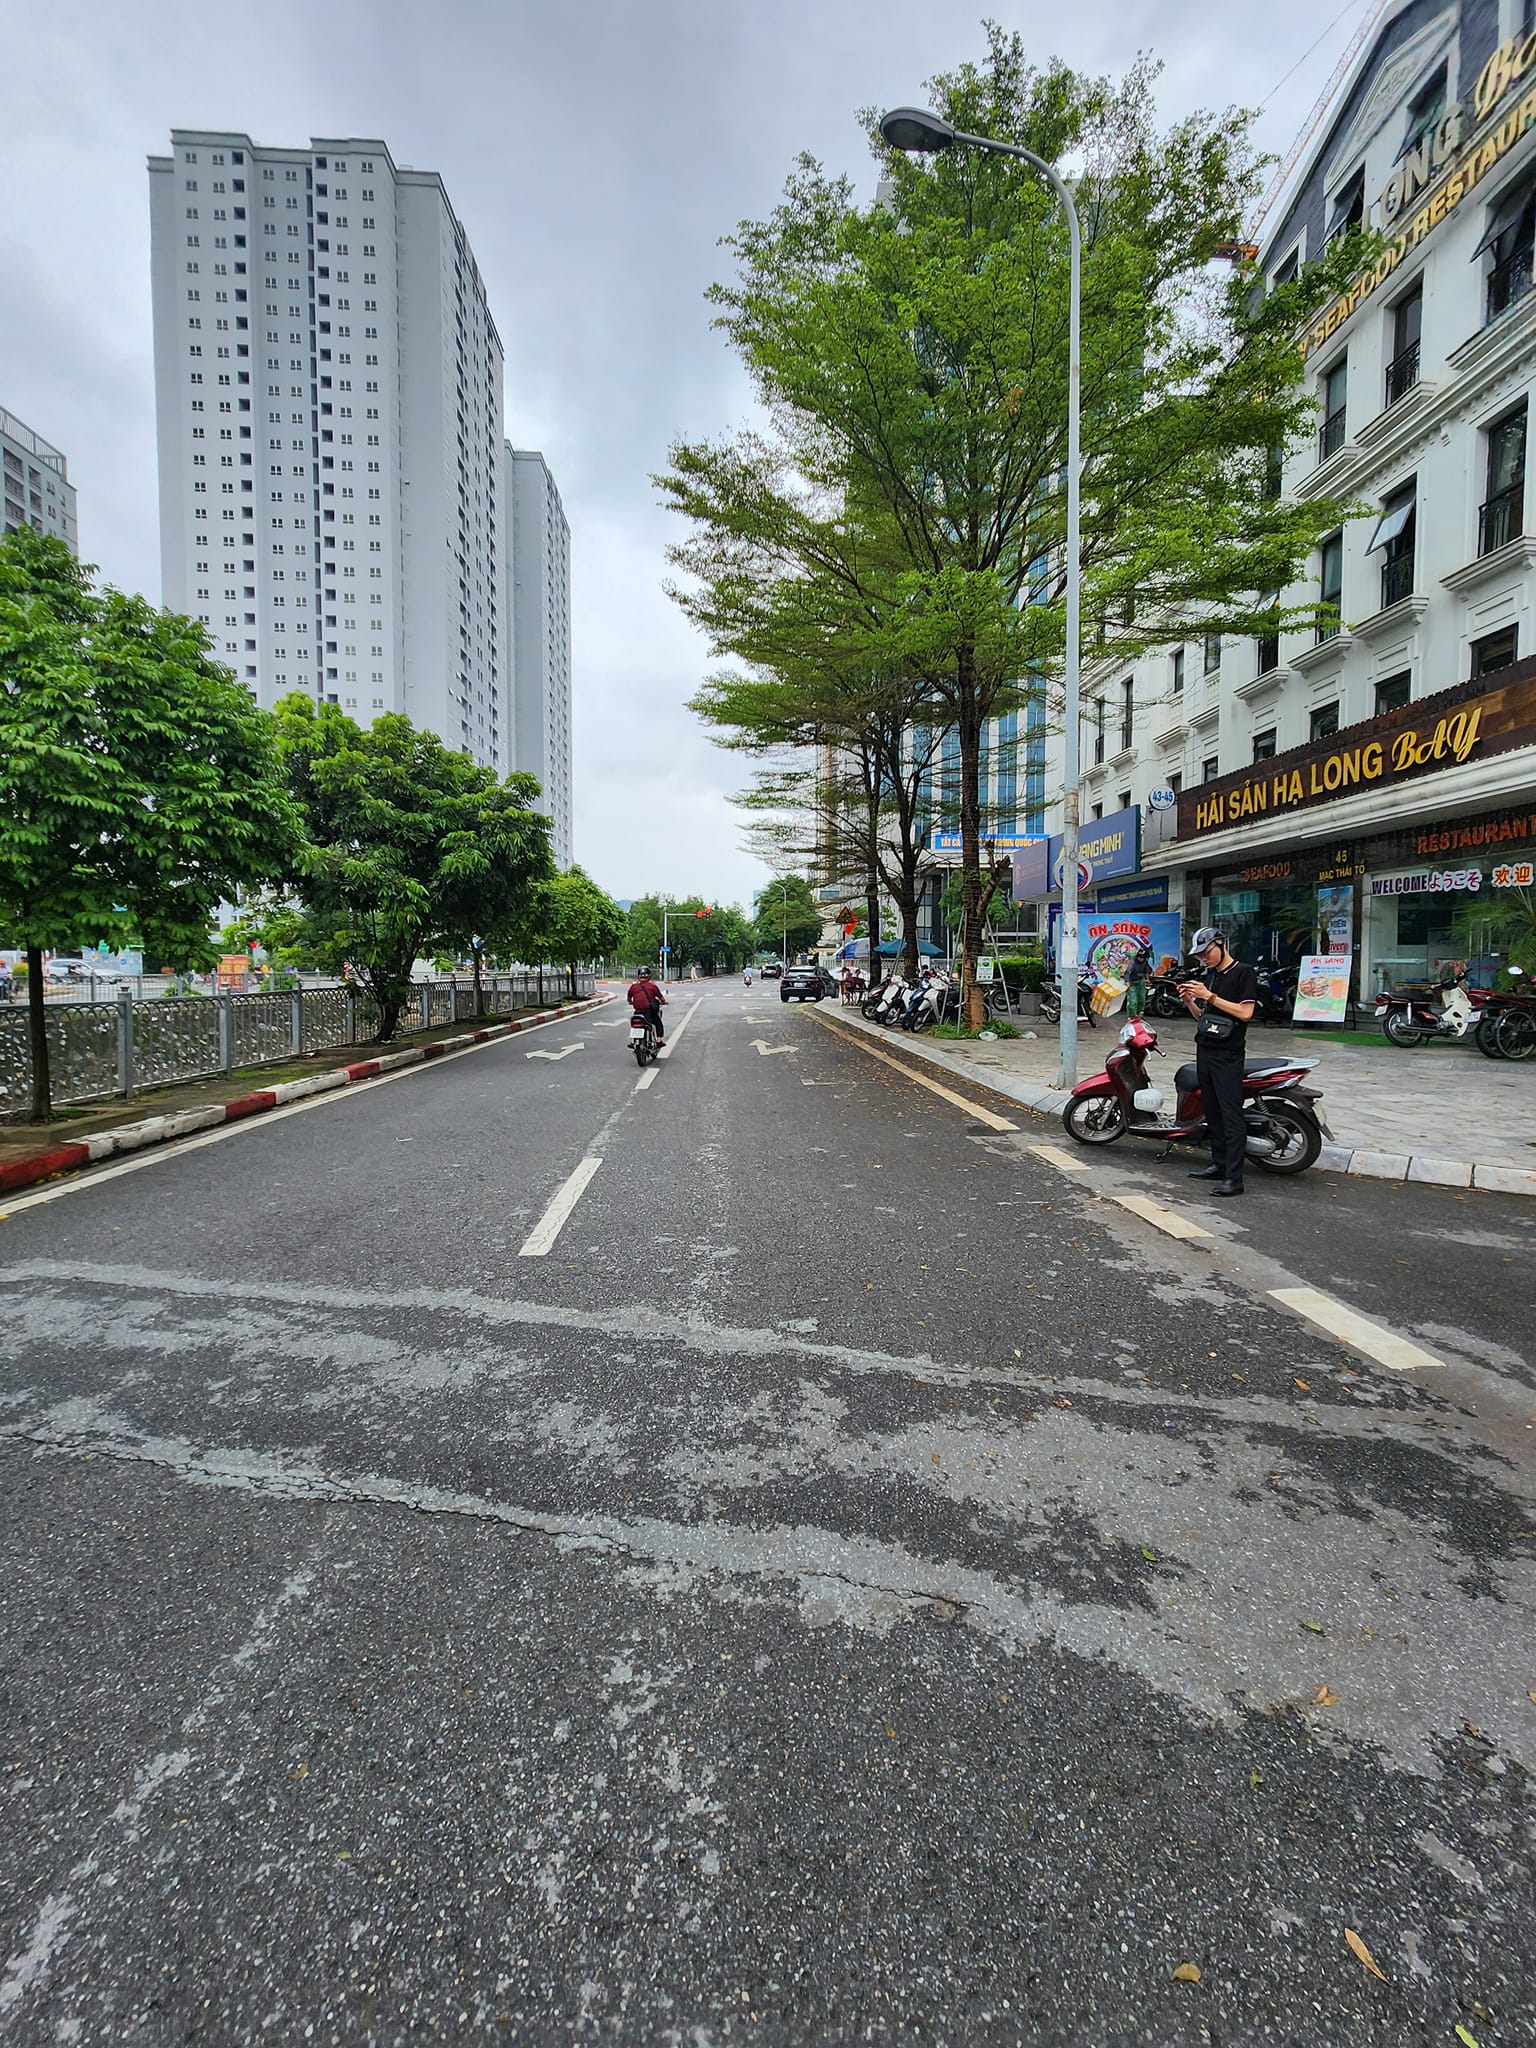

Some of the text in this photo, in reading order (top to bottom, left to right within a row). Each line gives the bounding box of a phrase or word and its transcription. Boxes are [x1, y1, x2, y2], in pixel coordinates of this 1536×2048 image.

[1313, 234, 1407, 348] SEAFOOD
[1196, 707, 1482, 830] HẢI SẢN HẠ LONG BAY
[1153, 791, 1173, 801] 43-45
[1415, 814, 1536, 854] RESTAURANT
[1335, 849, 1348, 863] 45
[1371, 874, 1428, 895] WELCOME
[1429, 871, 1480, 889] ようこそ
[1495, 865, 1531, 884] 欢迎
